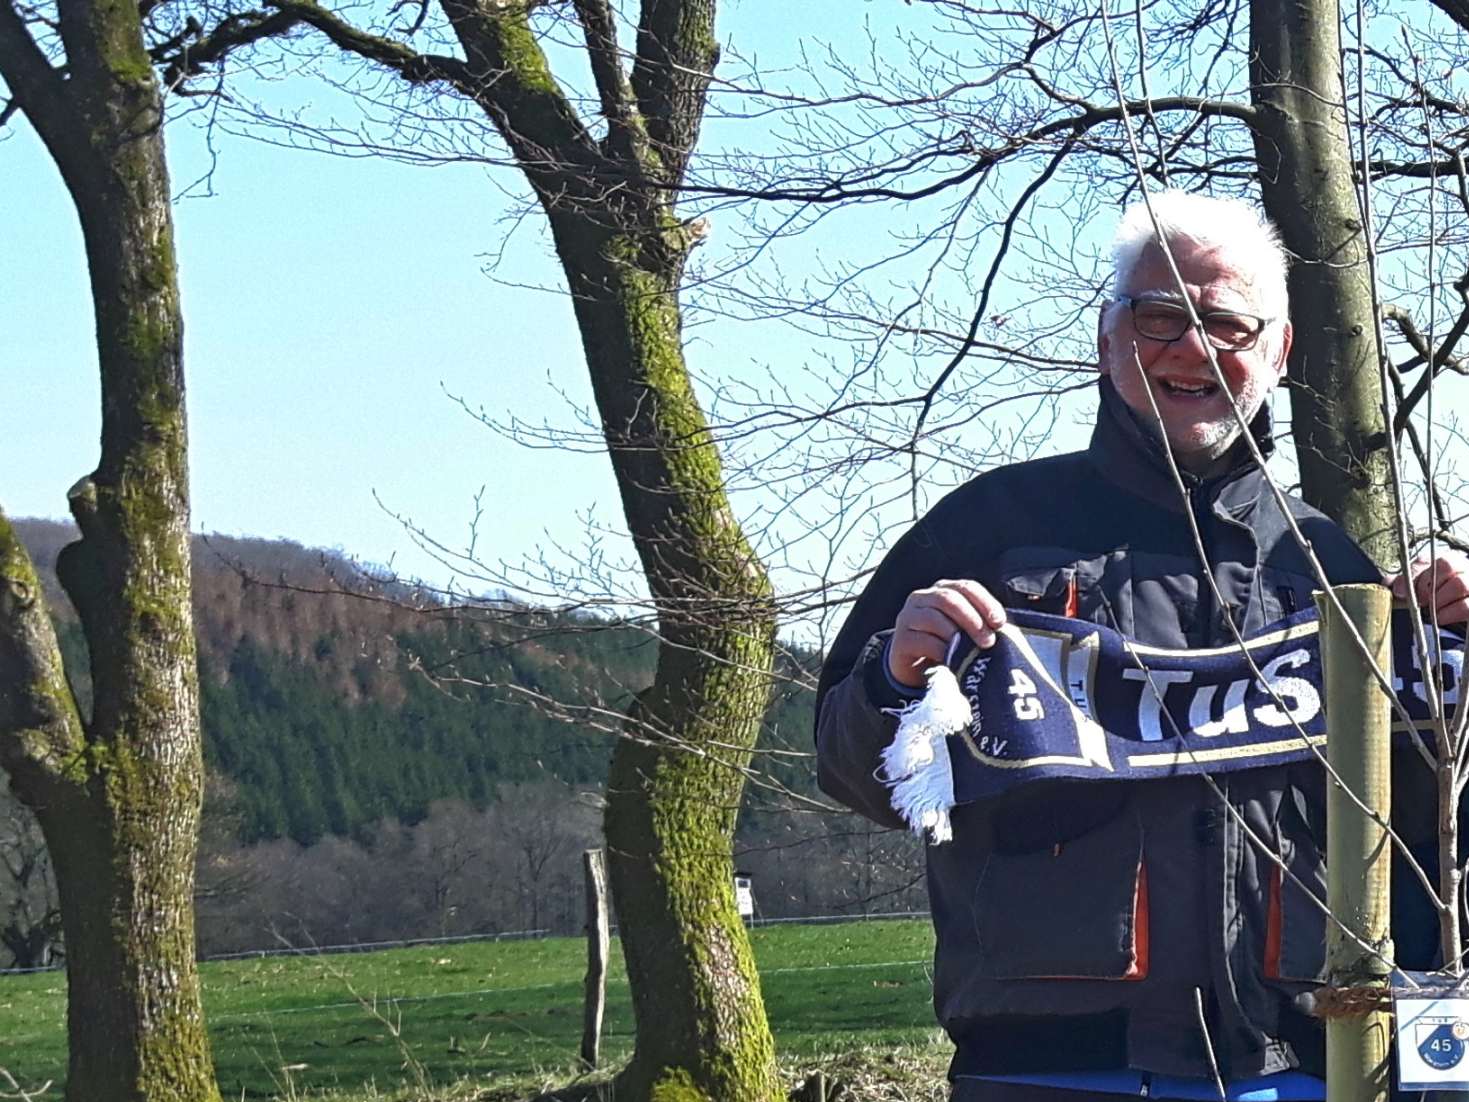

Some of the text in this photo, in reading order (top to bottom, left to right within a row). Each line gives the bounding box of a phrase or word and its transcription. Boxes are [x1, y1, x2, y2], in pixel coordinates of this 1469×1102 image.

[1007, 668, 1045, 721] 45
[1071, 679, 1094, 720] TU
[1124, 650, 1322, 741] TuS
[1430, 1038, 1452, 1052] 45
